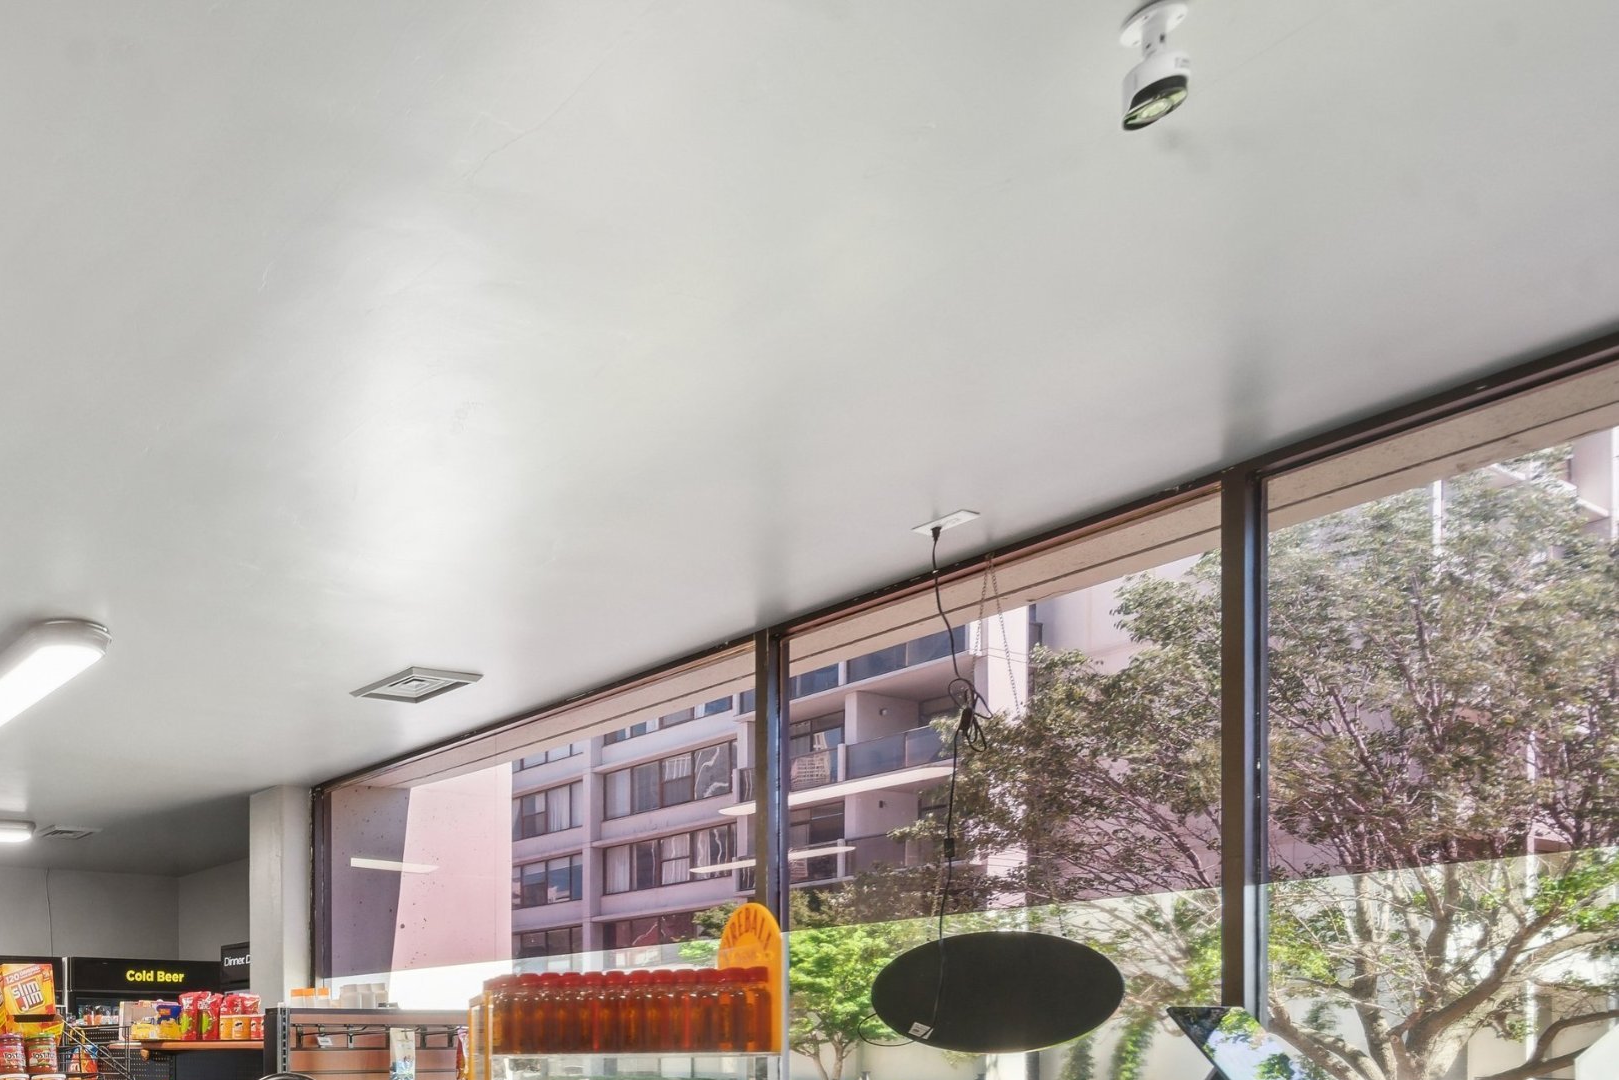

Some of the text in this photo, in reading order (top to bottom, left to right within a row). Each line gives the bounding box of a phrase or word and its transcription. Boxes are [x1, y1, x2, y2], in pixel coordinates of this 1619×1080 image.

[224, 955, 245, 967] Dinner
[6, 974, 20, 983] 120
[125, 970, 184, 982] Cold Beer
